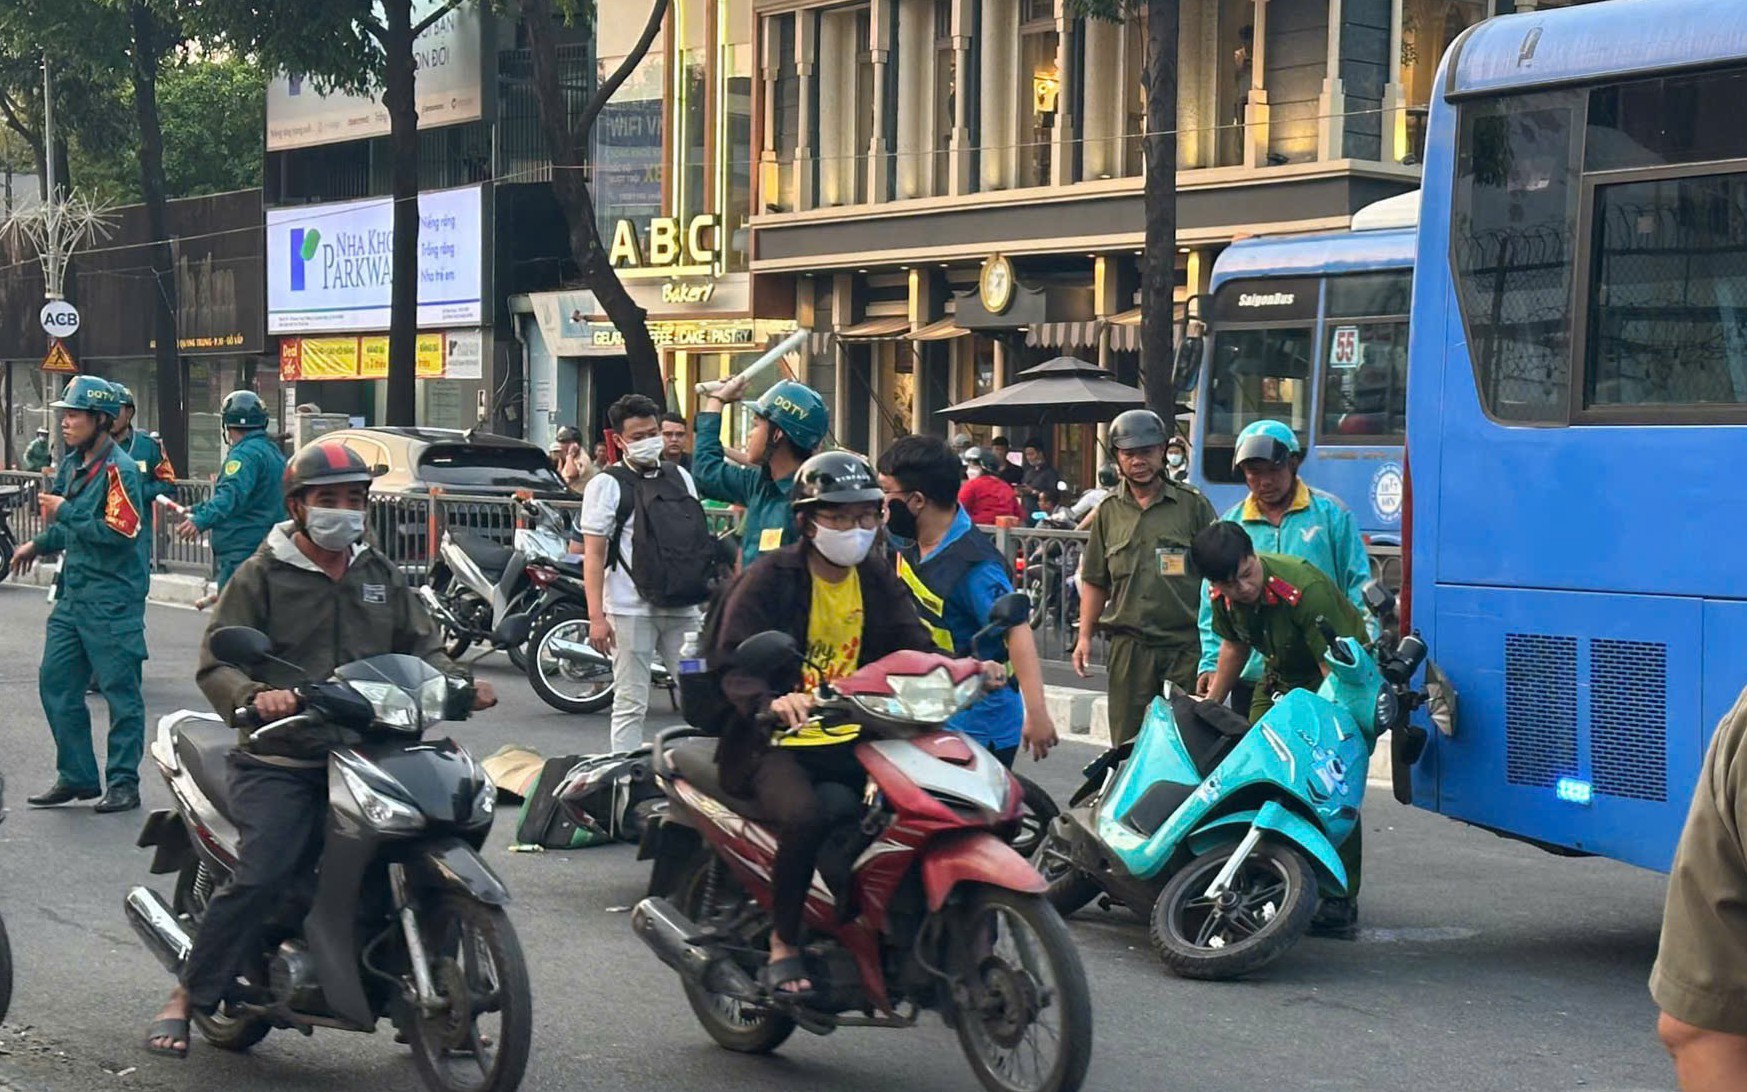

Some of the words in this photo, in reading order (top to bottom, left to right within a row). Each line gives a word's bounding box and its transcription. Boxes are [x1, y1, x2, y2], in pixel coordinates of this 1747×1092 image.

[609, 116, 642, 137] WIFI
[336, 232, 365, 258] NHA
[609, 214, 713, 266] ABC
[322, 244, 393, 290] PARKWA
[662, 283, 716, 304] Bakery
[1238, 293, 1295, 307] SaigonBus
[44, 312, 78, 326] ACB
[679, 330, 706, 344] CAKE
[711, 329, 750, 343] PASTRY
[1336, 331, 1356, 362] 55
[87, 389, 114, 402] DQTV
[774, 395, 809, 420] DQTV
